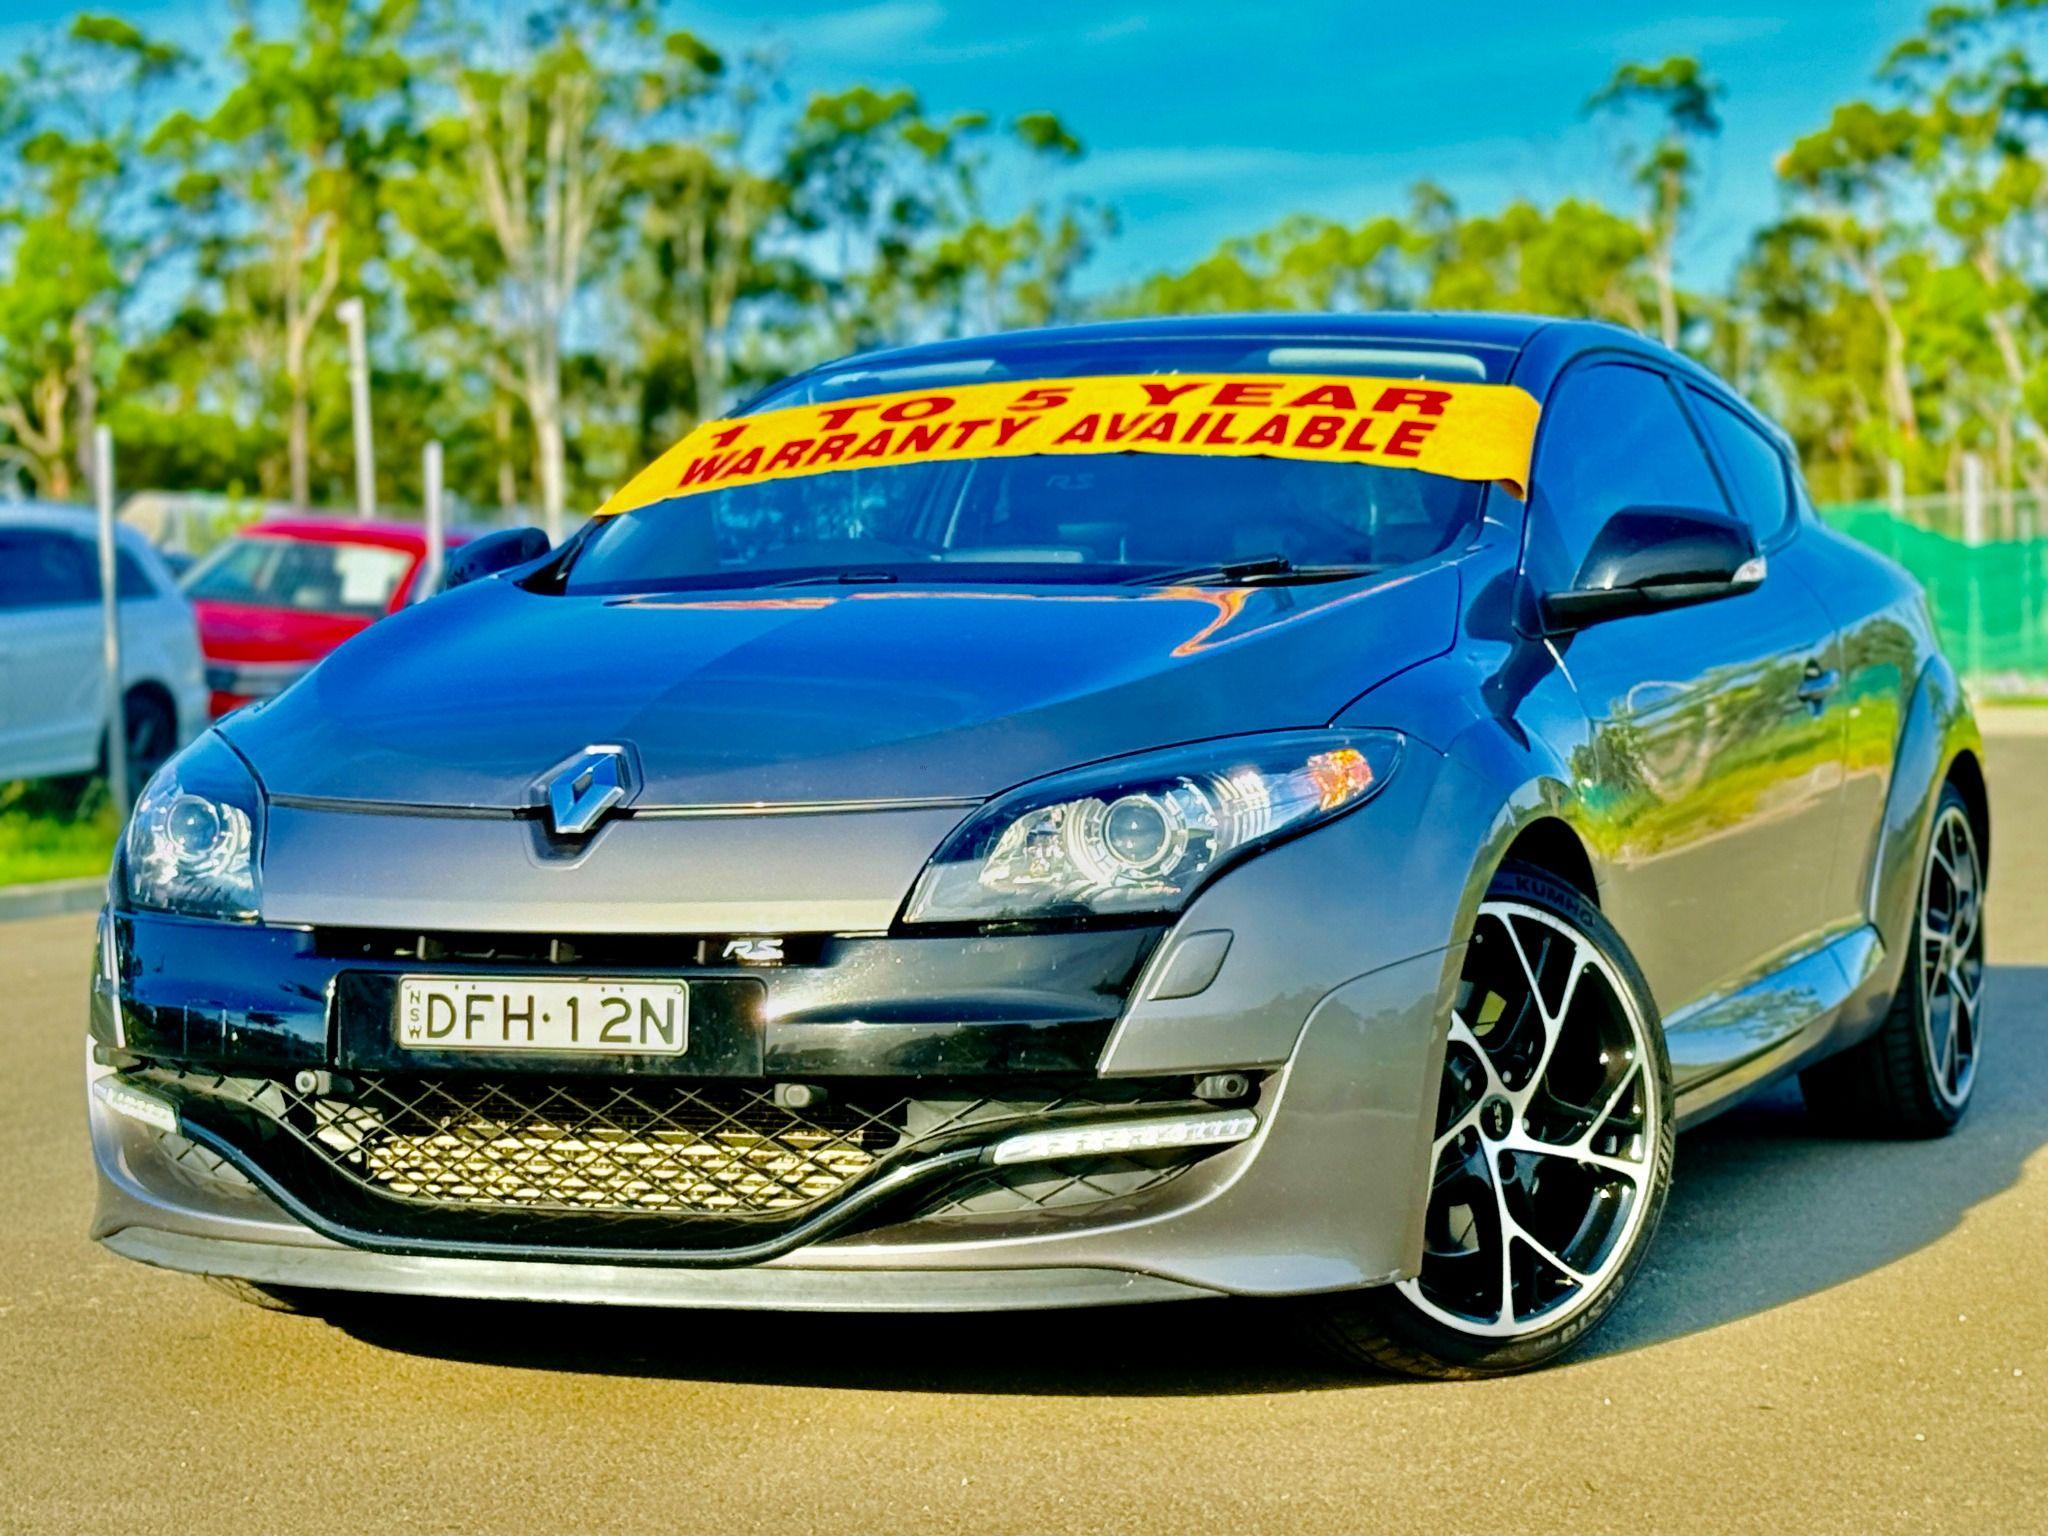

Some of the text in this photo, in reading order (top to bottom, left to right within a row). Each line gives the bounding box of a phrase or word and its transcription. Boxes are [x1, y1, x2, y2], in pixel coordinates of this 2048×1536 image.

[712, 382, 1453, 450] 1 TO 5 YEAR
[677, 412, 1437, 488] WARRANTY AVAILABLE
[1514, 875, 1596, 929] KUMHO
[722, 938, 785, 961] RS
